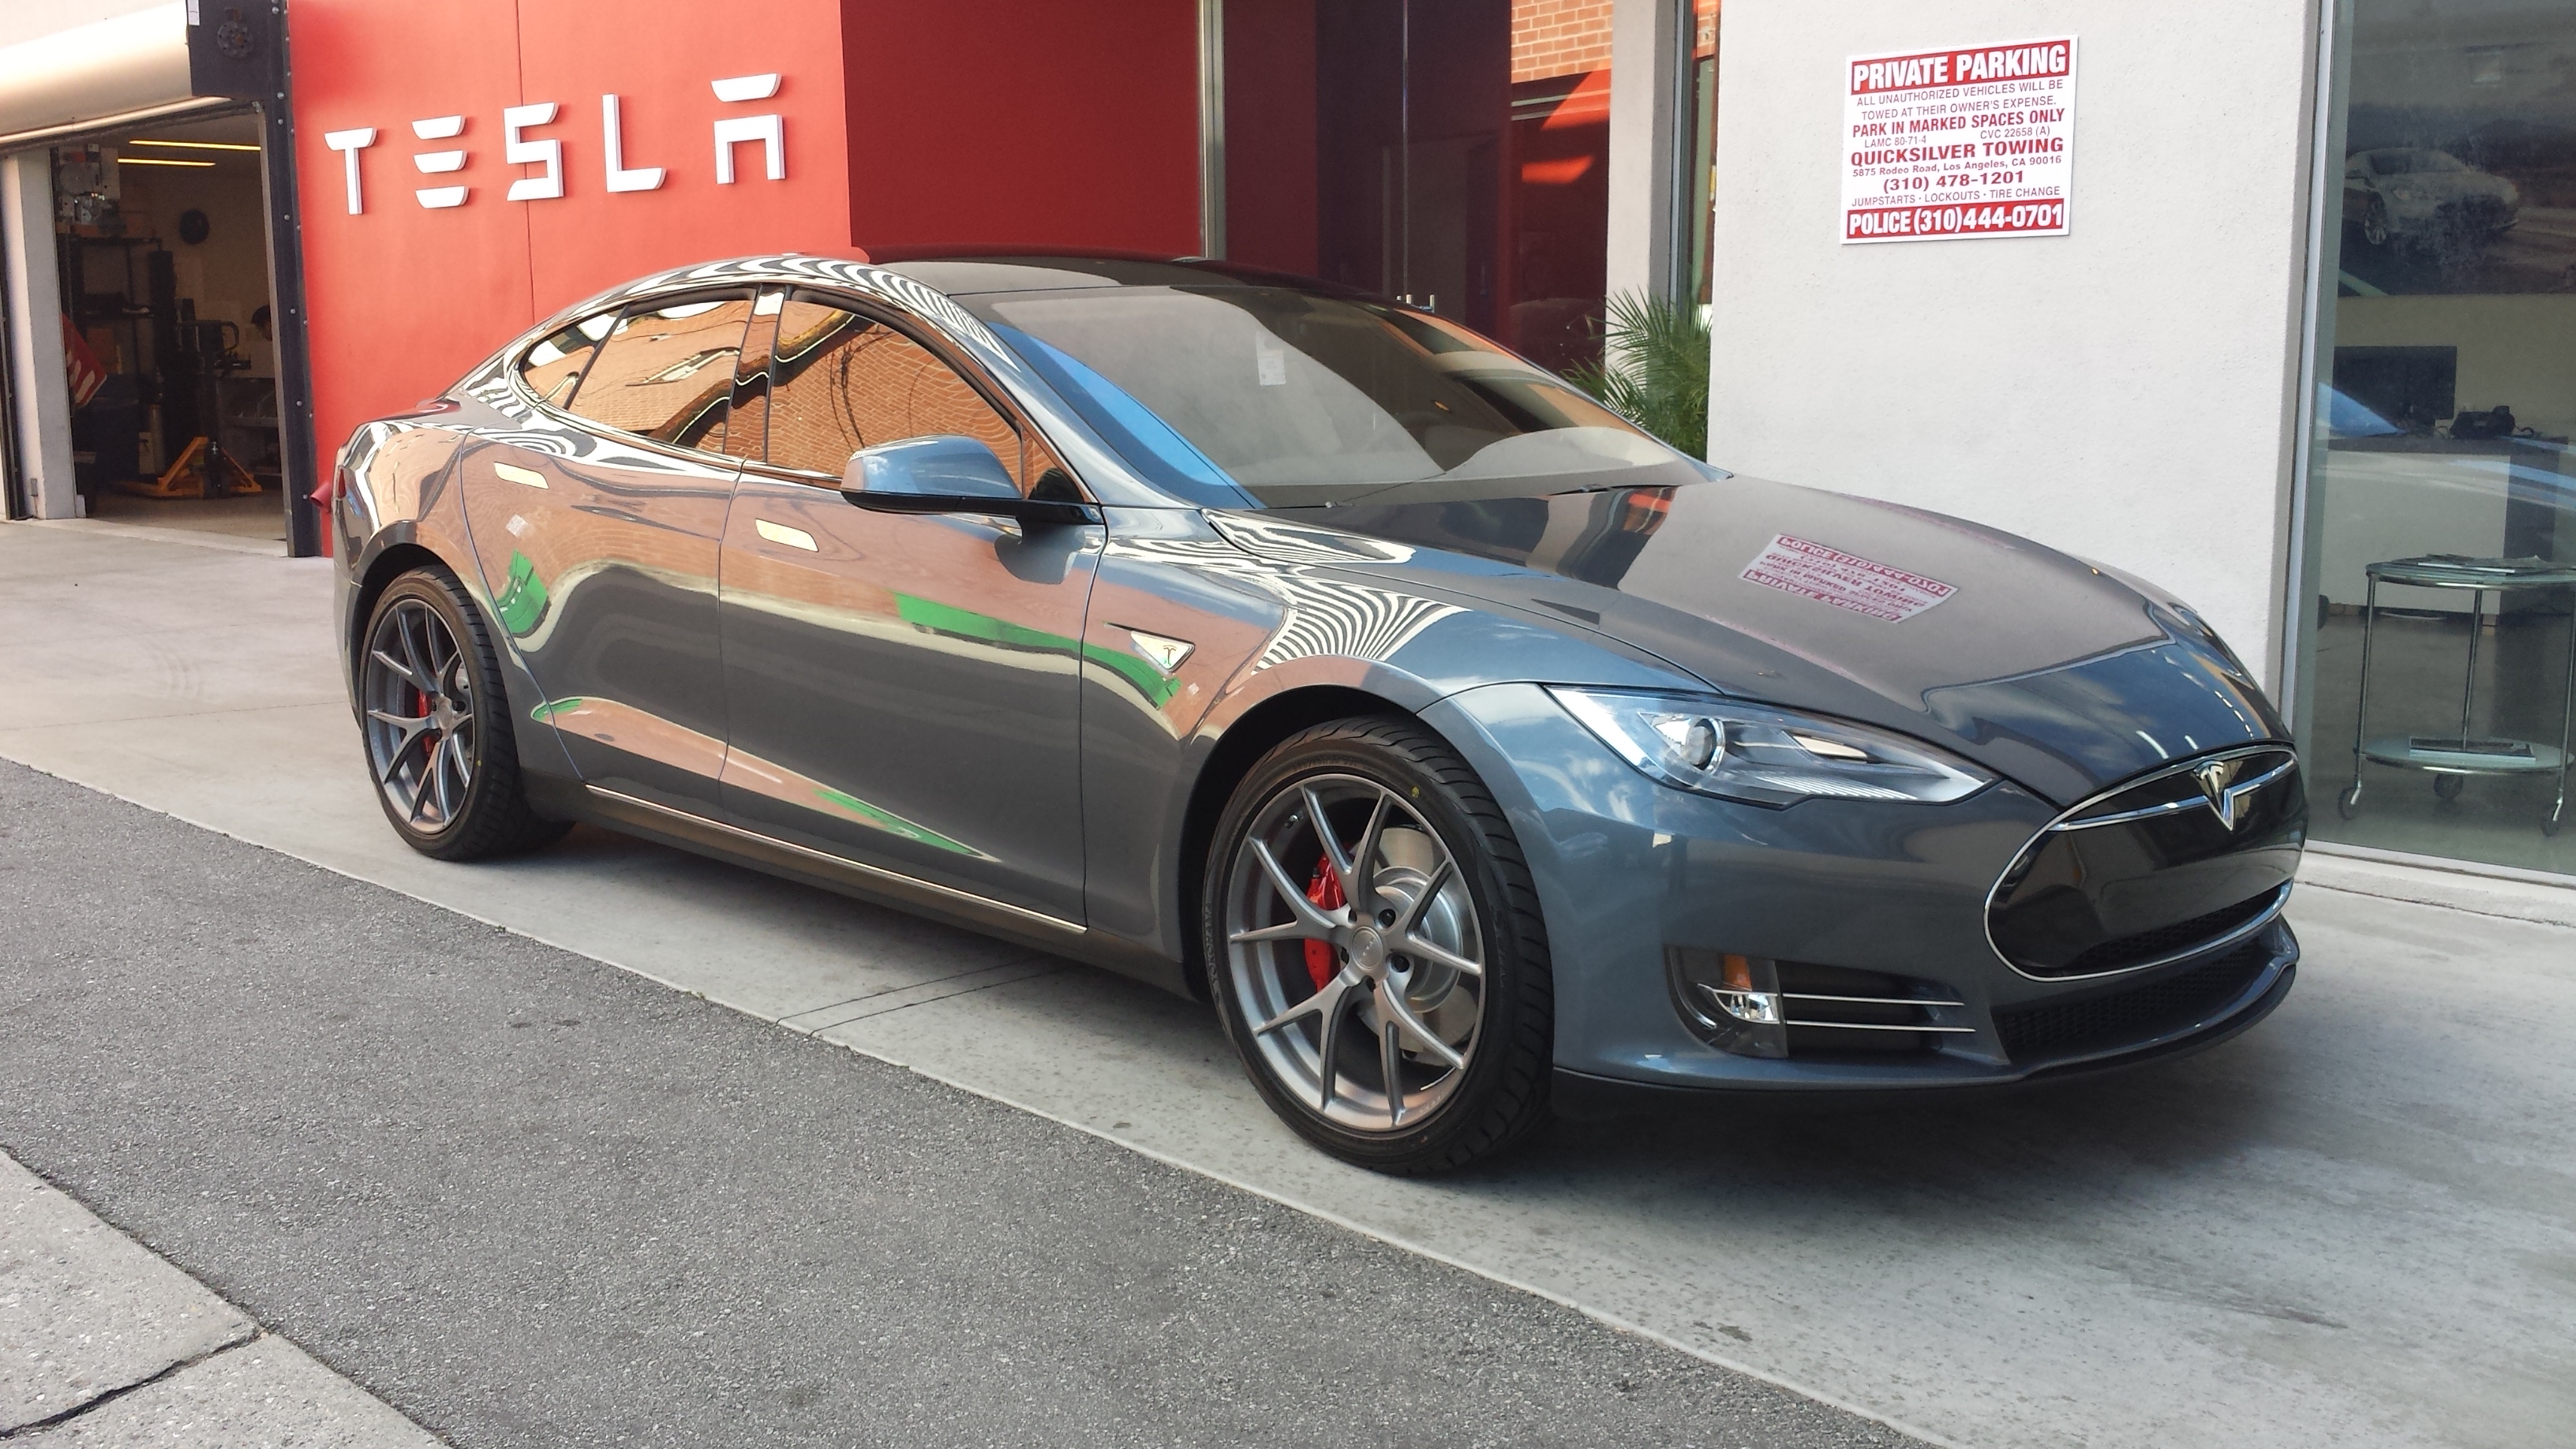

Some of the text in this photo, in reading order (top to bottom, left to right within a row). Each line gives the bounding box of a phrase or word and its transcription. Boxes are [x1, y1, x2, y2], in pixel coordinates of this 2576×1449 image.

[1853, 44, 2066, 92] PRIVATE PARKING
[1856, 79, 2063, 107] ALL UNAUTHORIZED VEHICLES WILL BE
[1861, 95, 2057, 120] TOWED AT THEIR OWNER'S EXPENSE.
[1852, 107, 2065, 138] PARK IN MARKED SPACES ONLY
[1980, 125, 2050, 140] CVC 22658 (A)
[324, 73, 785, 215] TESLA
[1851, 137, 2063, 167] QUICKSILVER TOWING
[1864, 135, 1926, 148] LAMC 80-71-4
[1852, 155, 2061, 177] 5875 Rodeo Road, Los Angeles, CA 90016
[1883, 170, 2024, 194] (310) 478-1201
[1852, 185, 2061, 207] JUMPSTARTS LOCKOUTS TIRE CHANGE
[1849, 211, 1911, 235] POLICE
[1205, 902, 1219, 984] YOKOHAMA
